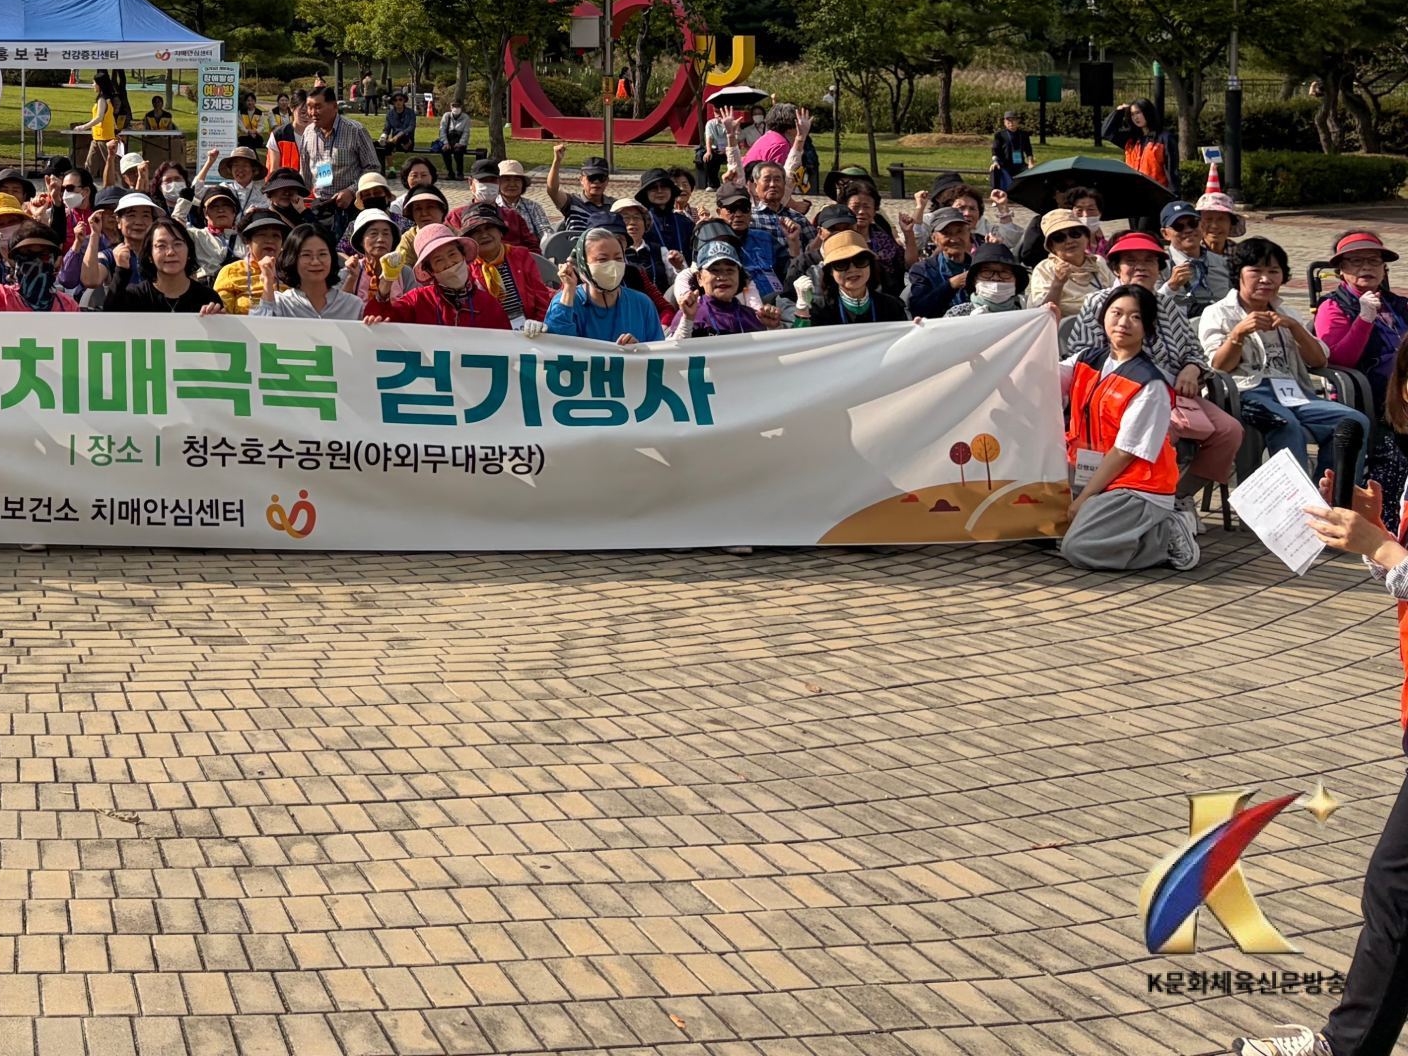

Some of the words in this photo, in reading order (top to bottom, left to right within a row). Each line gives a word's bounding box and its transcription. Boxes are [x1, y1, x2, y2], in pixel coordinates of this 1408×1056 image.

[62, 49, 119, 60] 건강증진센터
[0, 338, 338, 421] 치매극복
[375, 350, 716, 427] 걷기행사
[1279, 387, 1295, 397] 17
[182, 433, 545, 477] 청수호수공원(야외무대광장)
[91, 496, 245, 528] 치매안심센터
